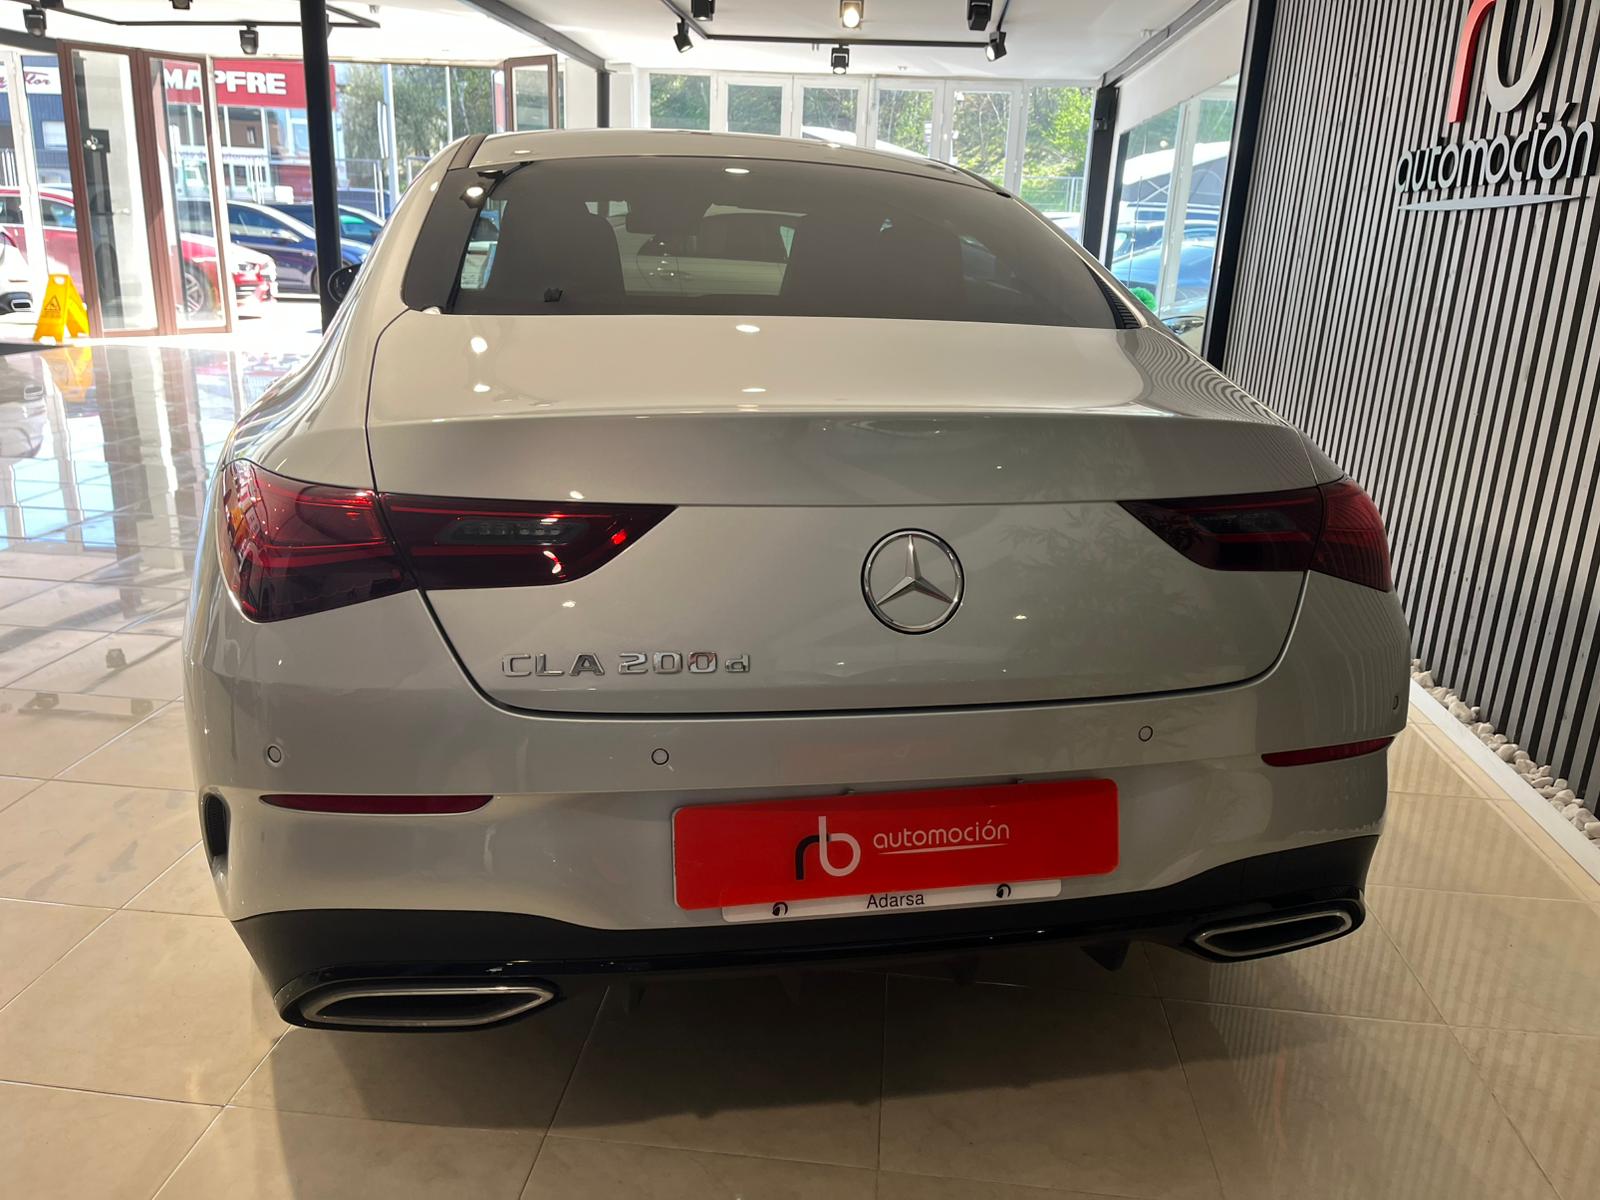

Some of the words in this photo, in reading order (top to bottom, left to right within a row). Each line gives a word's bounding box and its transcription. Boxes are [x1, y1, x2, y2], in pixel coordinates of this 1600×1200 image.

[163, 68, 287, 95] MAPFRE
[1395, 103, 1594, 192] automoción
[502, 653, 605, 677] CLA
[617, 652, 718, 675] 200
[795, 815, 861, 881] rb
[873, 820, 1010, 849] automoción
[866, 893, 925, 910] Adarsa
